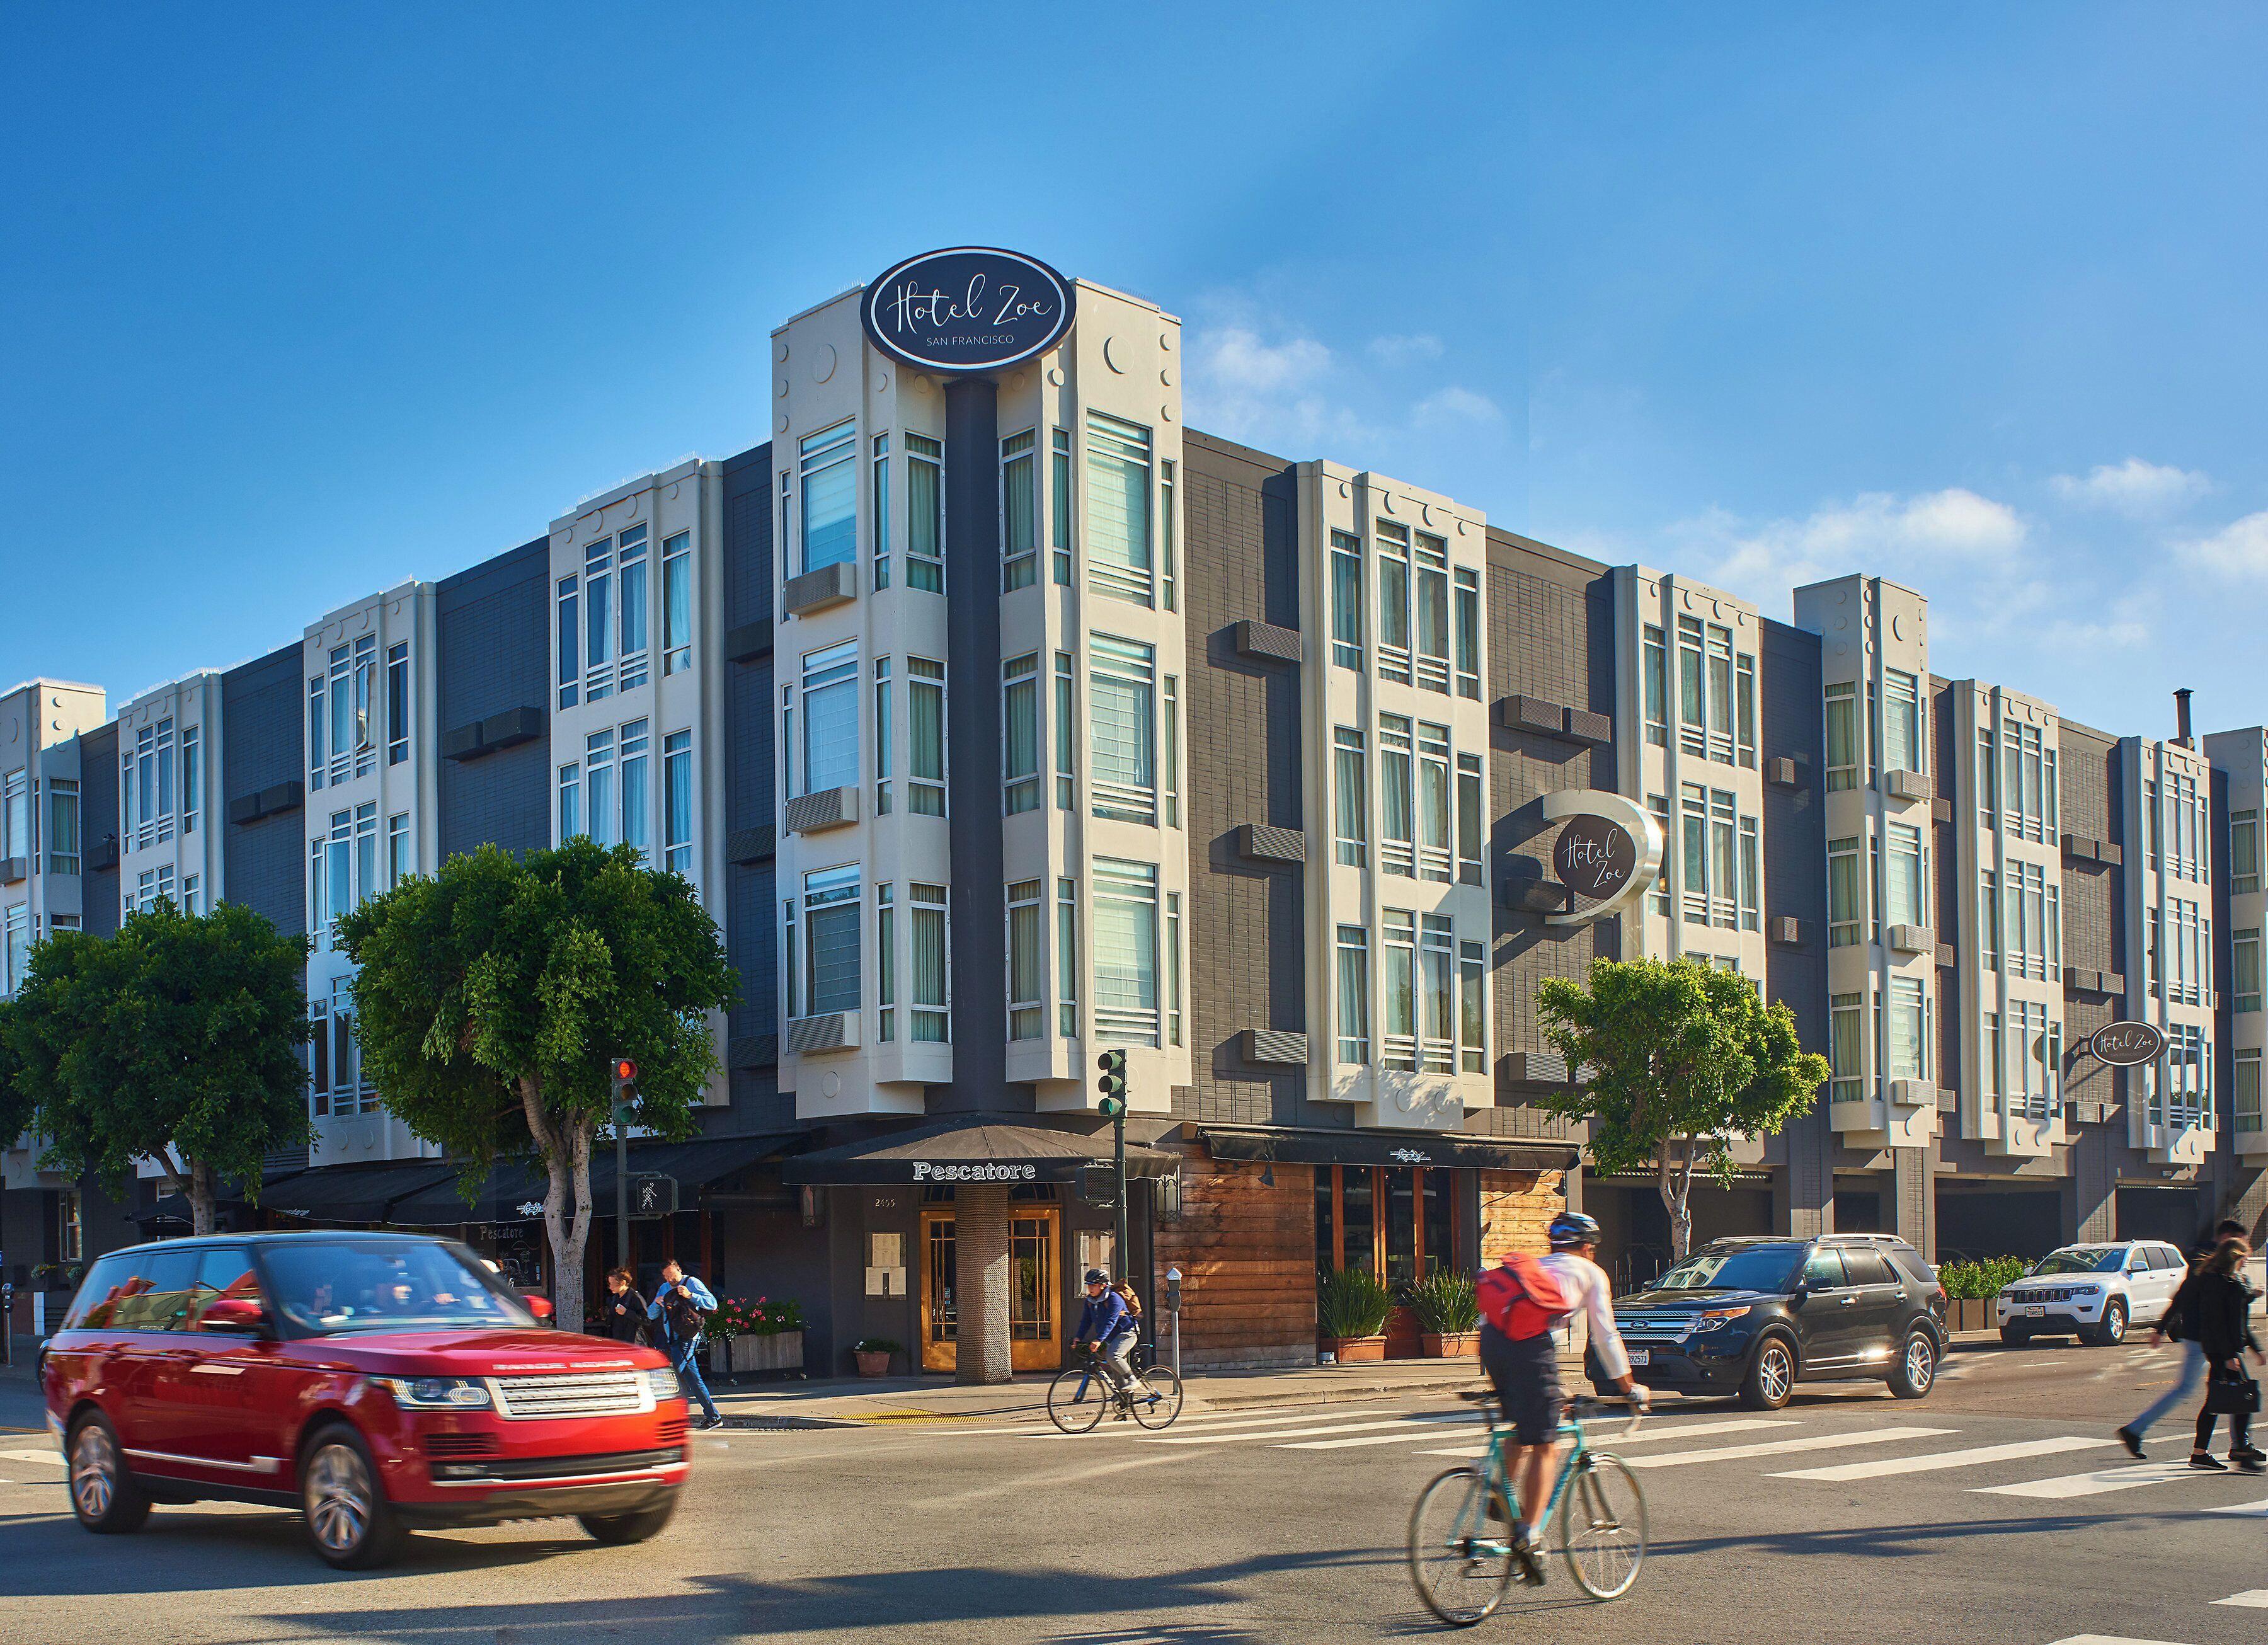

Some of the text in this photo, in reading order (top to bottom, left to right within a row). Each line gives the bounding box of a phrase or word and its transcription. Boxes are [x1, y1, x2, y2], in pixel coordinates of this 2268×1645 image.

[886, 273, 1053, 335] Hotel Zoe
[926, 335, 1014, 347] SAN FRANCISCO
[1562, 828, 1618, 869] Hotel
[1593, 860, 1626, 888] Zoe
[2097, 1029, 2155, 1053] Hotel Zoe
[913, 1162, 1036, 1181] Pescatore
[875, 1198, 895, 1207] 2455
[479, 1225, 524, 1241] Pescatore
